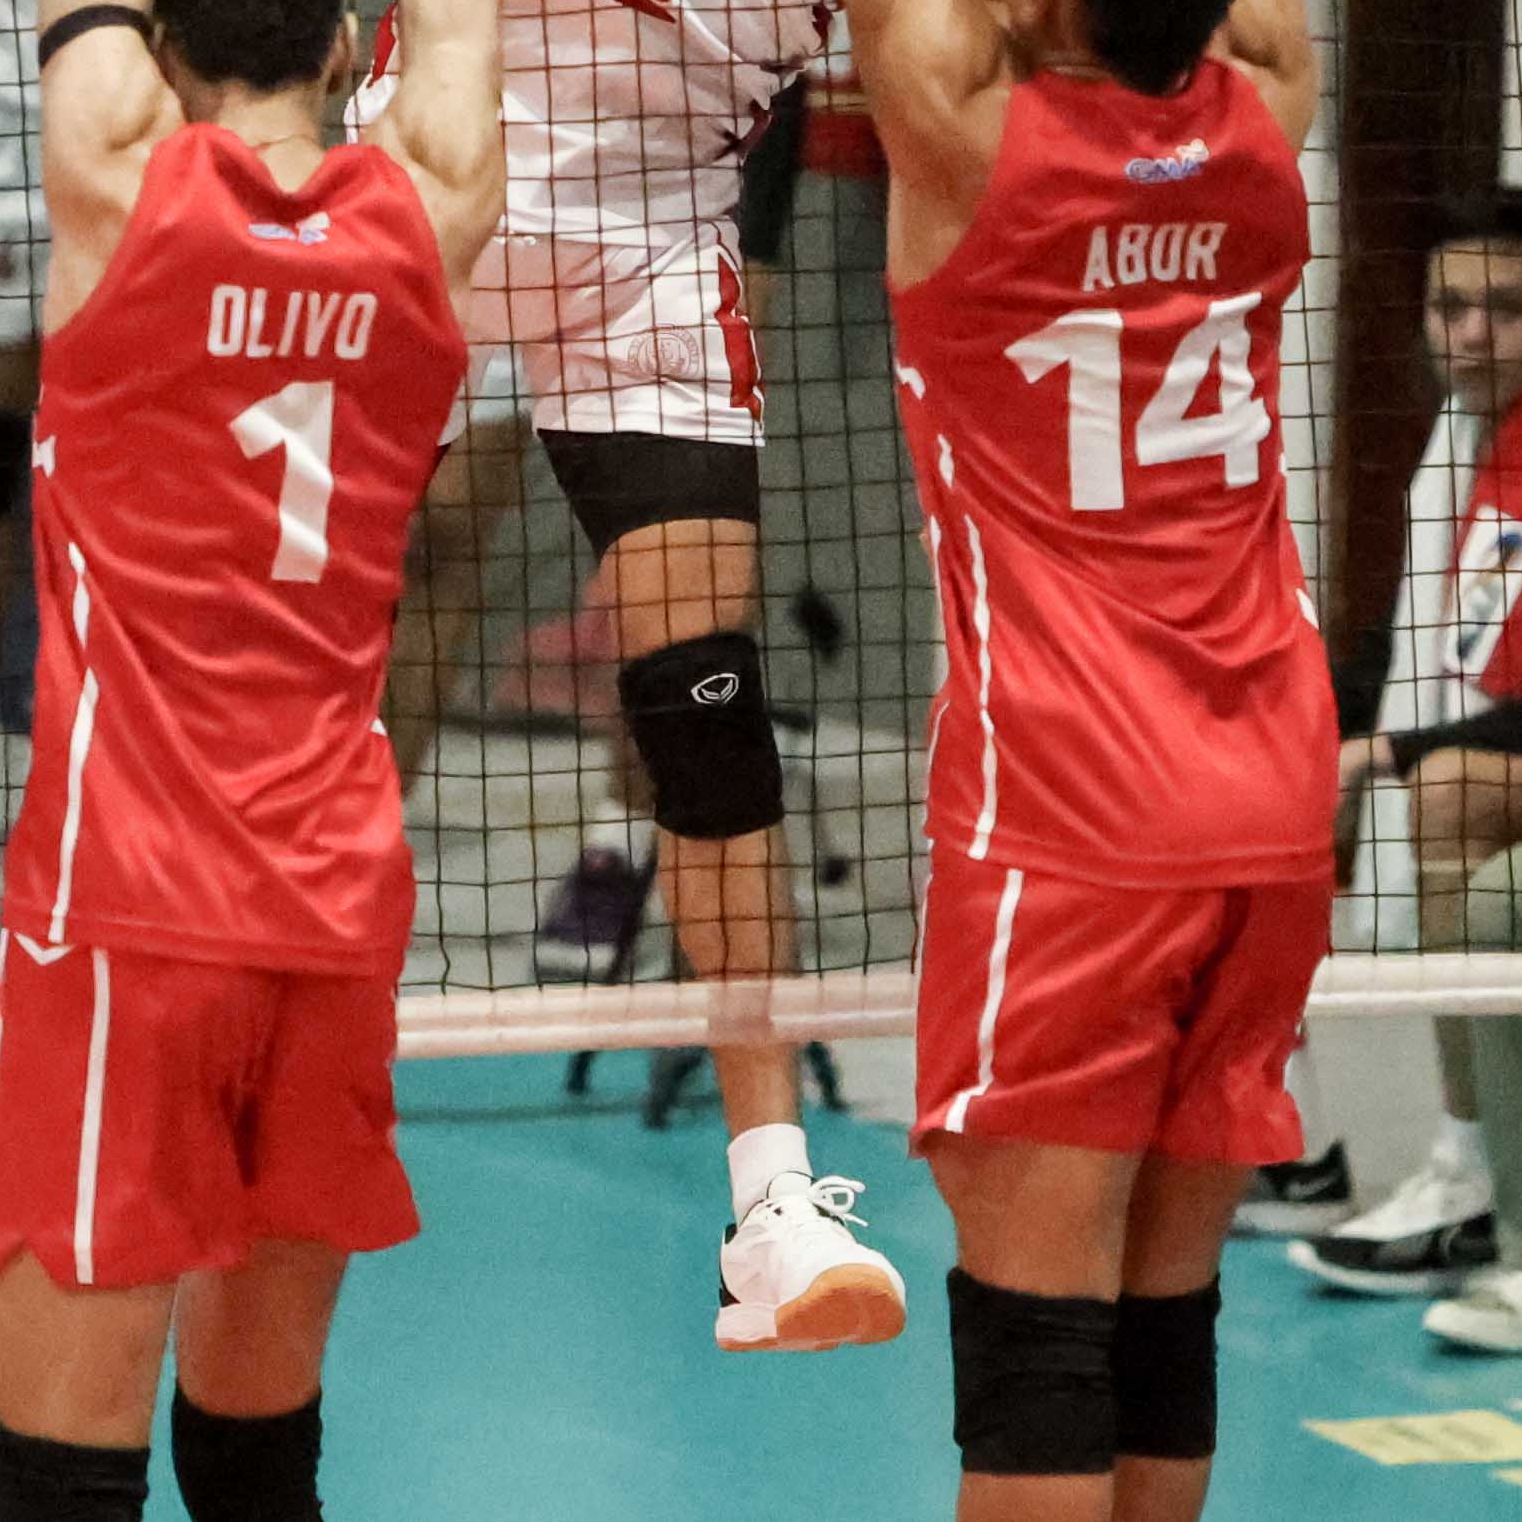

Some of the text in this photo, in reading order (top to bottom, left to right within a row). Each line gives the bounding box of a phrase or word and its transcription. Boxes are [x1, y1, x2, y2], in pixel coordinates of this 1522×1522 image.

[207, 284, 378, 360] OLIVO
[1082, 221, 1228, 292] ABOR
[1004, 291, 1272, 511] 14
[229, 381, 334, 584] 1
